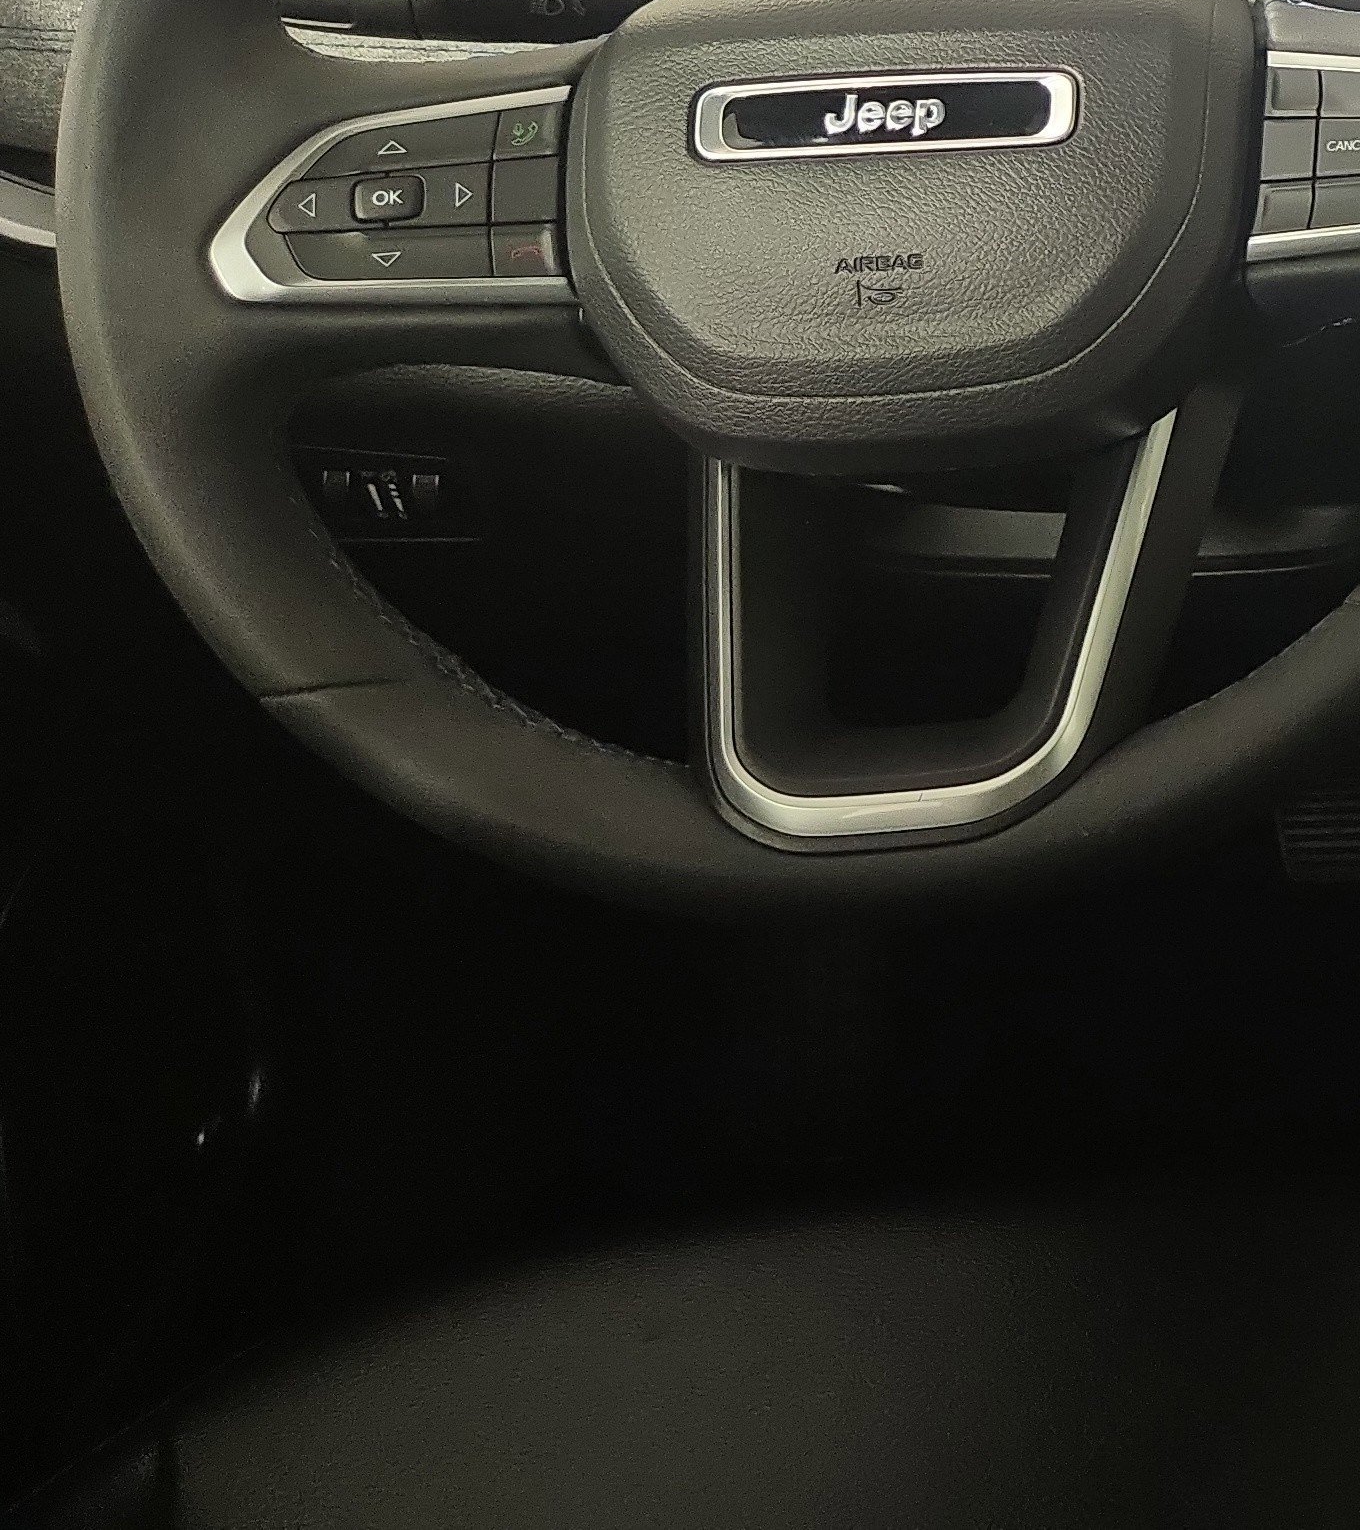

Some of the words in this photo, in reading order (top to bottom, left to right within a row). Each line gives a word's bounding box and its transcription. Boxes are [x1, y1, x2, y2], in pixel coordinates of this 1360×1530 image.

[823, 93, 946, 138] Jeep
[371, 188, 404, 207] OK
[834, 253, 924, 274] AIRBAG
